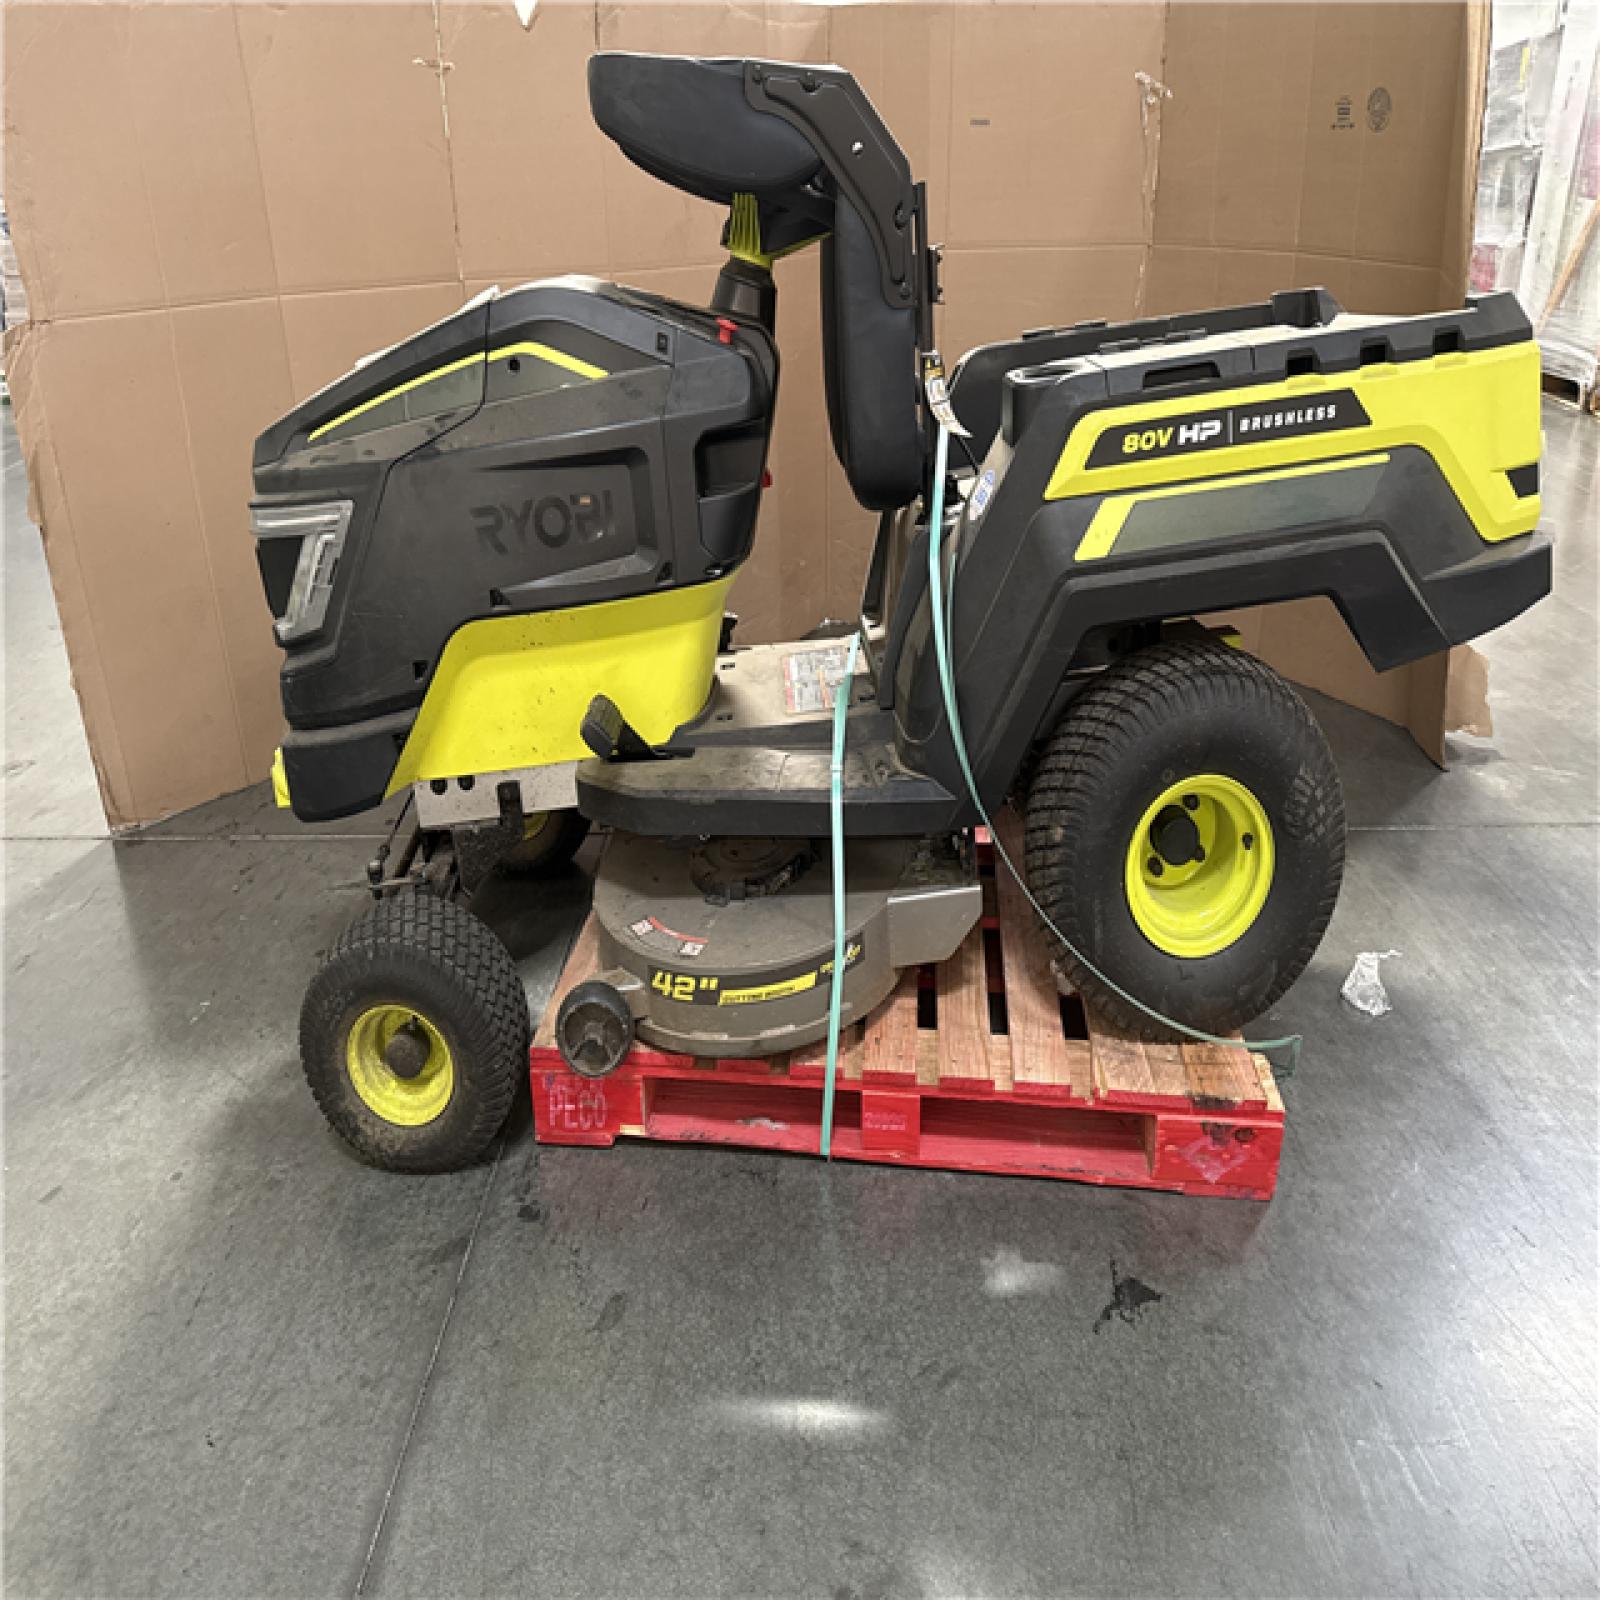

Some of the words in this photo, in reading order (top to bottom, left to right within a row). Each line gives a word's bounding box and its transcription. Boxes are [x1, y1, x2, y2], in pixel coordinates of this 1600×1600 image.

[1122, 427, 1175, 452] 80V
[1178, 419, 1222, 445] HP
[1240, 404, 1336, 433] BRUSHLESS
[470, 490, 614, 555] RYOBI
[652, 970, 719, 1001] 42"
